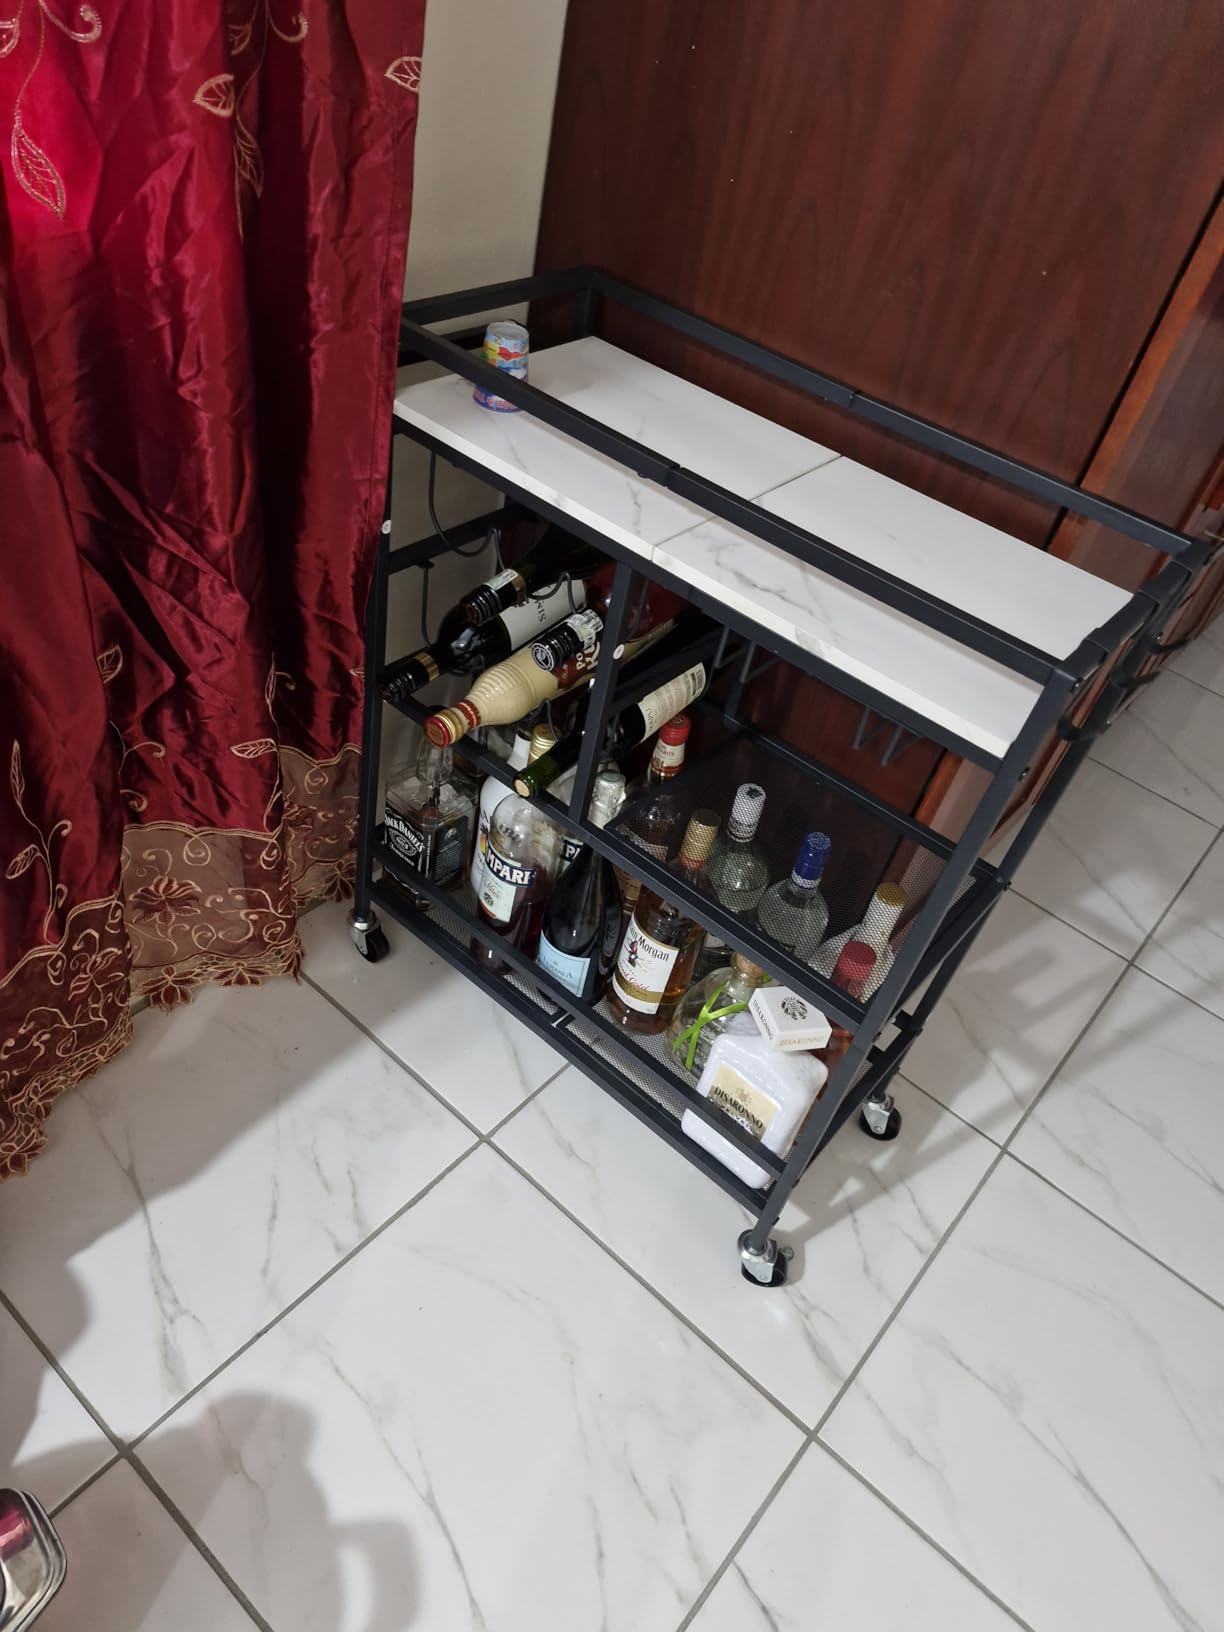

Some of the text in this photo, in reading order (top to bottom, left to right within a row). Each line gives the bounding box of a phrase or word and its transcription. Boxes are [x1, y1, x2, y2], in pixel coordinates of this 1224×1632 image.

[399, 821, 426, 853] DANIEL'S
[486, 851, 531, 885] MPARI
[637, 936, 670, 963] Morgan
[753, 999, 774, 1042] DISARONNO
[714, 1086, 764, 1130] DISARONNO
